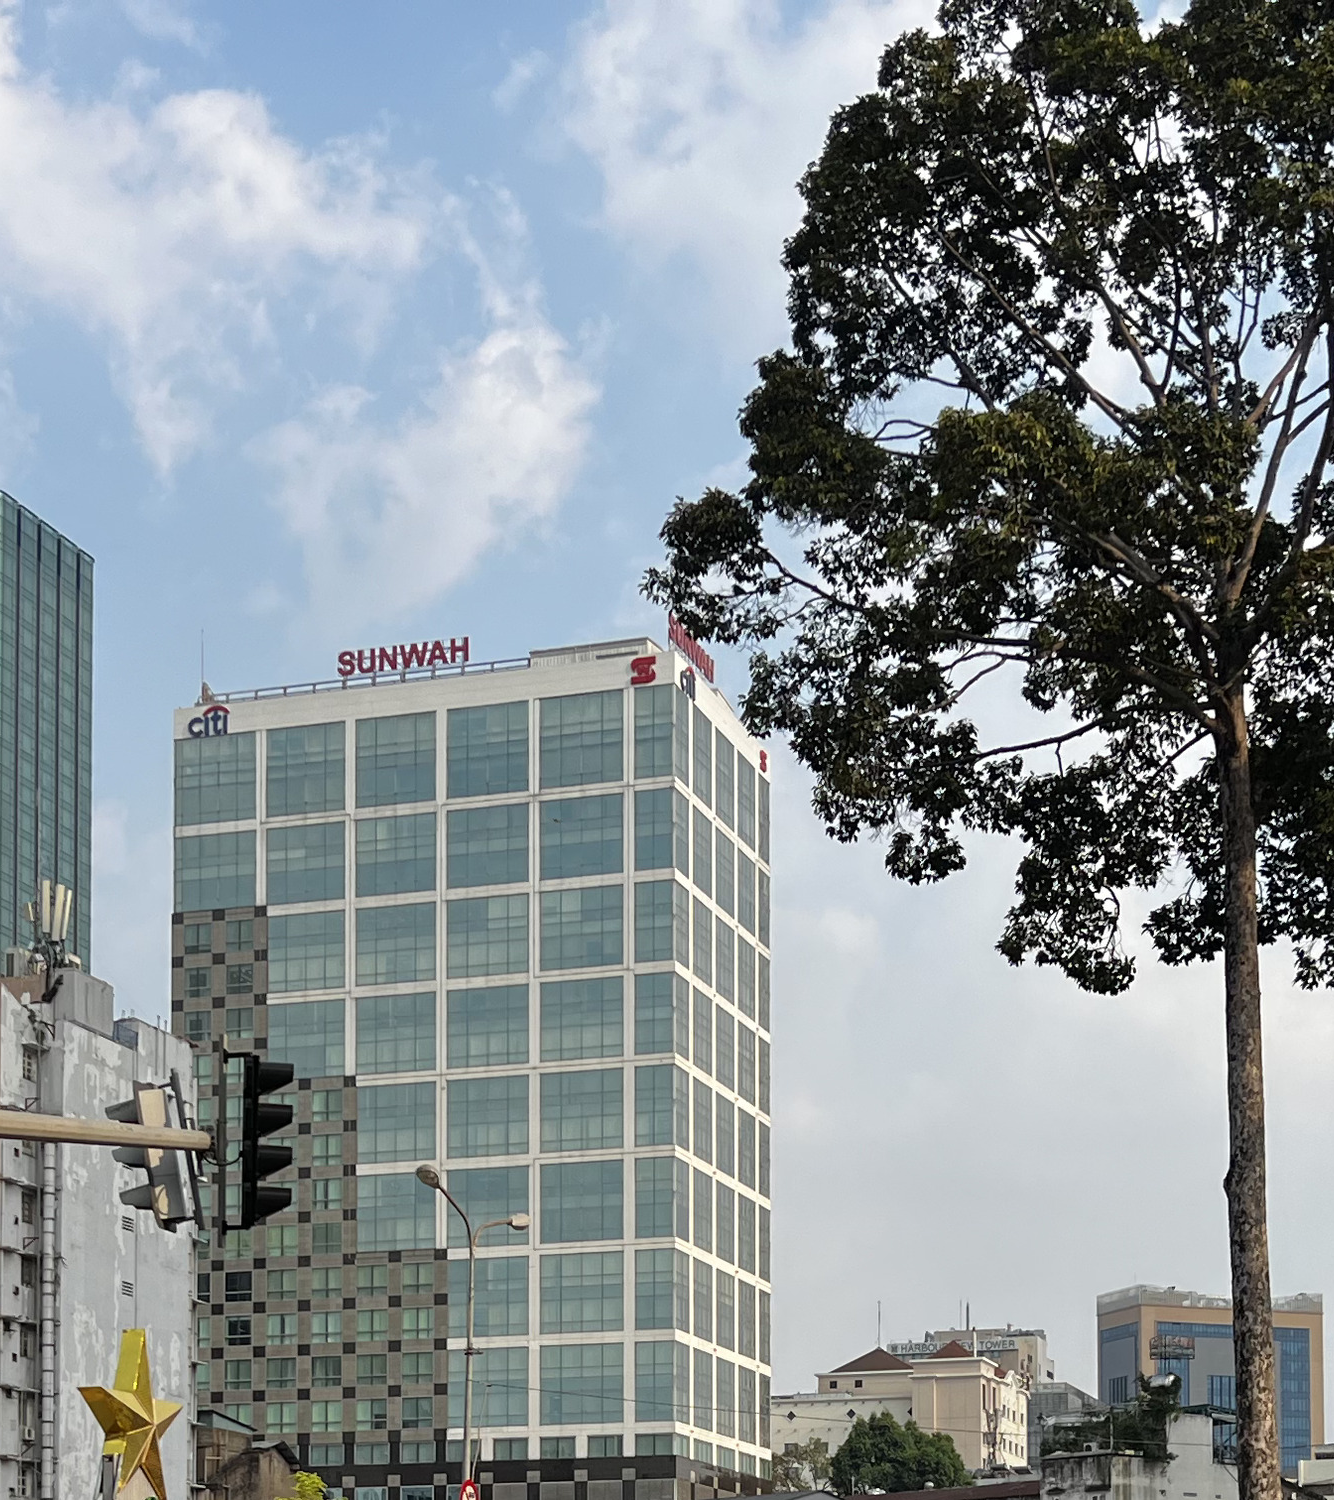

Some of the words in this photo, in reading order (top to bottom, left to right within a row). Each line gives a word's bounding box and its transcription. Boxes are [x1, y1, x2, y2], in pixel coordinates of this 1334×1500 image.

[337, 636, 469, 676] SUNWAH
[187, 705, 229, 738] citi
[979, 1339, 1016, 1351] TOWER
